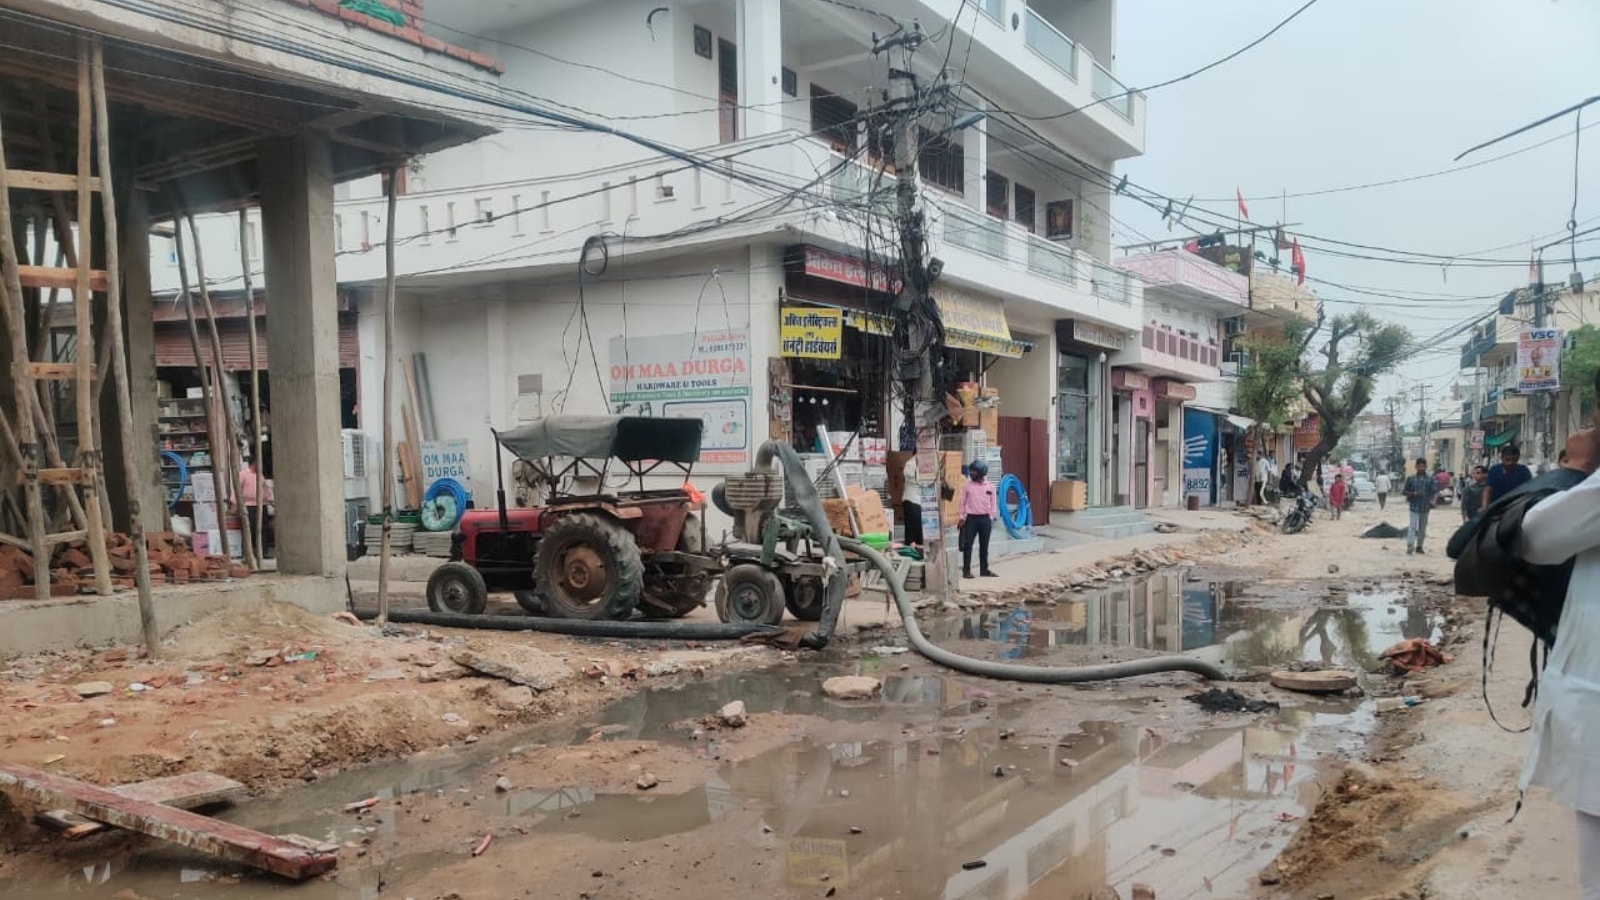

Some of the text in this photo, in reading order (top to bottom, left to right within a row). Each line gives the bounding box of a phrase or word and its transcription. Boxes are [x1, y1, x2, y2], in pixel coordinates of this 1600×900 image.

[1530, 330, 1555, 339] VSC
[610, 357, 746, 380] OM MAA DURGA
[636, 380, 681, 391] HARDWARE
[691, 379, 718, 388] TOOLS
[423, 453, 465, 465] OM MAA
[428, 466, 464, 477] DURGA
